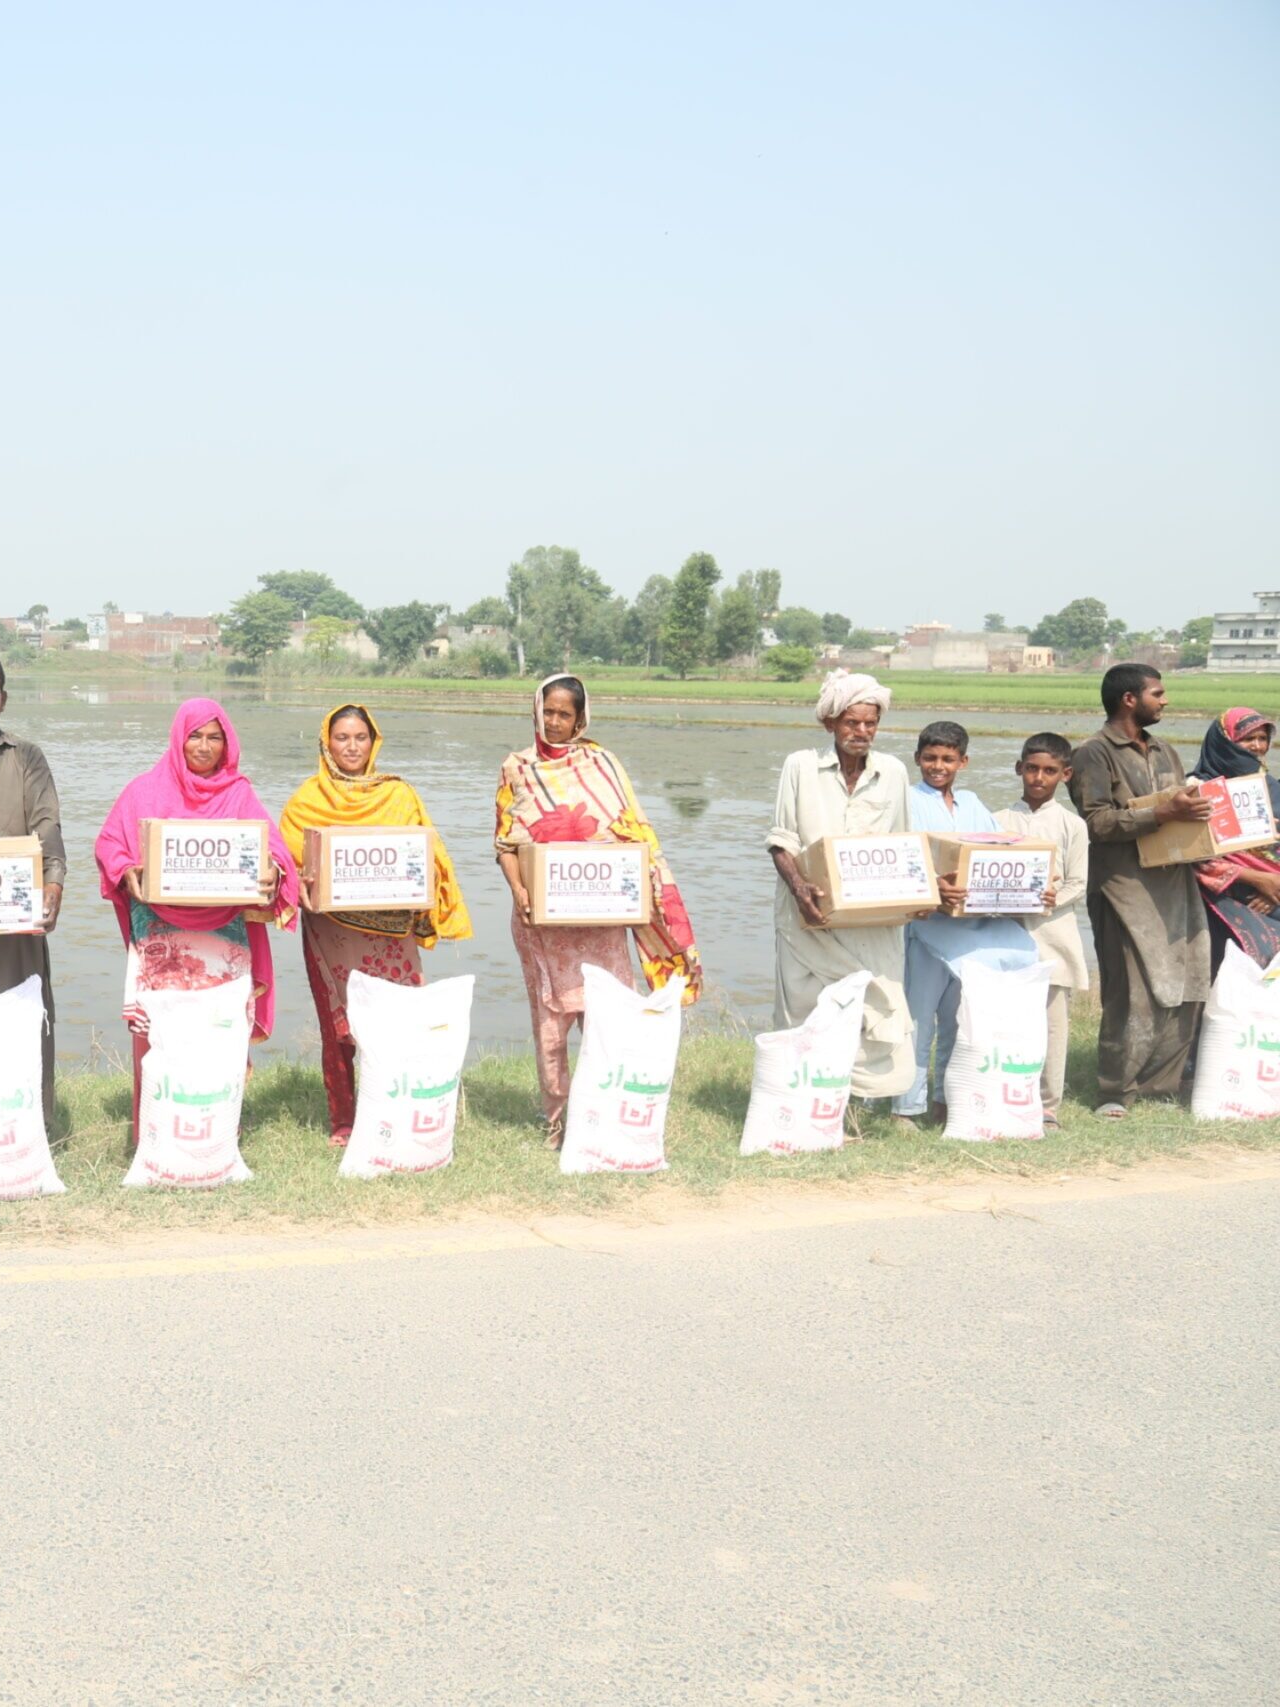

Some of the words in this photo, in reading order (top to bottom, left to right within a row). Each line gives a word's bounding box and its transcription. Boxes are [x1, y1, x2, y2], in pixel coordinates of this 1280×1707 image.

[165, 838, 231, 857] FLOOD
[334, 847, 398, 867] FLOOD
[165, 858, 202, 868] RELIEF
[205, 858, 230, 868] BOX
[839, 848, 897, 867] FLOOD
[335, 867, 370, 877] RELIEF
[373, 866, 397, 876] BOX
[549, 862, 612, 881] FLOOD
[972, 861, 1025, 879] FLOOD
[550, 881, 584, 891] RELIEF
[588, 880, 612, 891] BOX
[970, 879, 1000, 888] RELIEF
[1002, 879, 1024, 888] BOX
[1226, 1075, 1240, 1085] 20
[1002, 1081, 1034, 1106] آٹا
[620, 1100, 657, 1127] آٹا
[779, 1112, 792, 1122] 20
[810, 1096, 845, 1120] آٹا
[173, 1114, 216, 1140] آٹا
[412, 1103, 450, 1133] آٹا
[379, 1127, 392, 1139] 20
